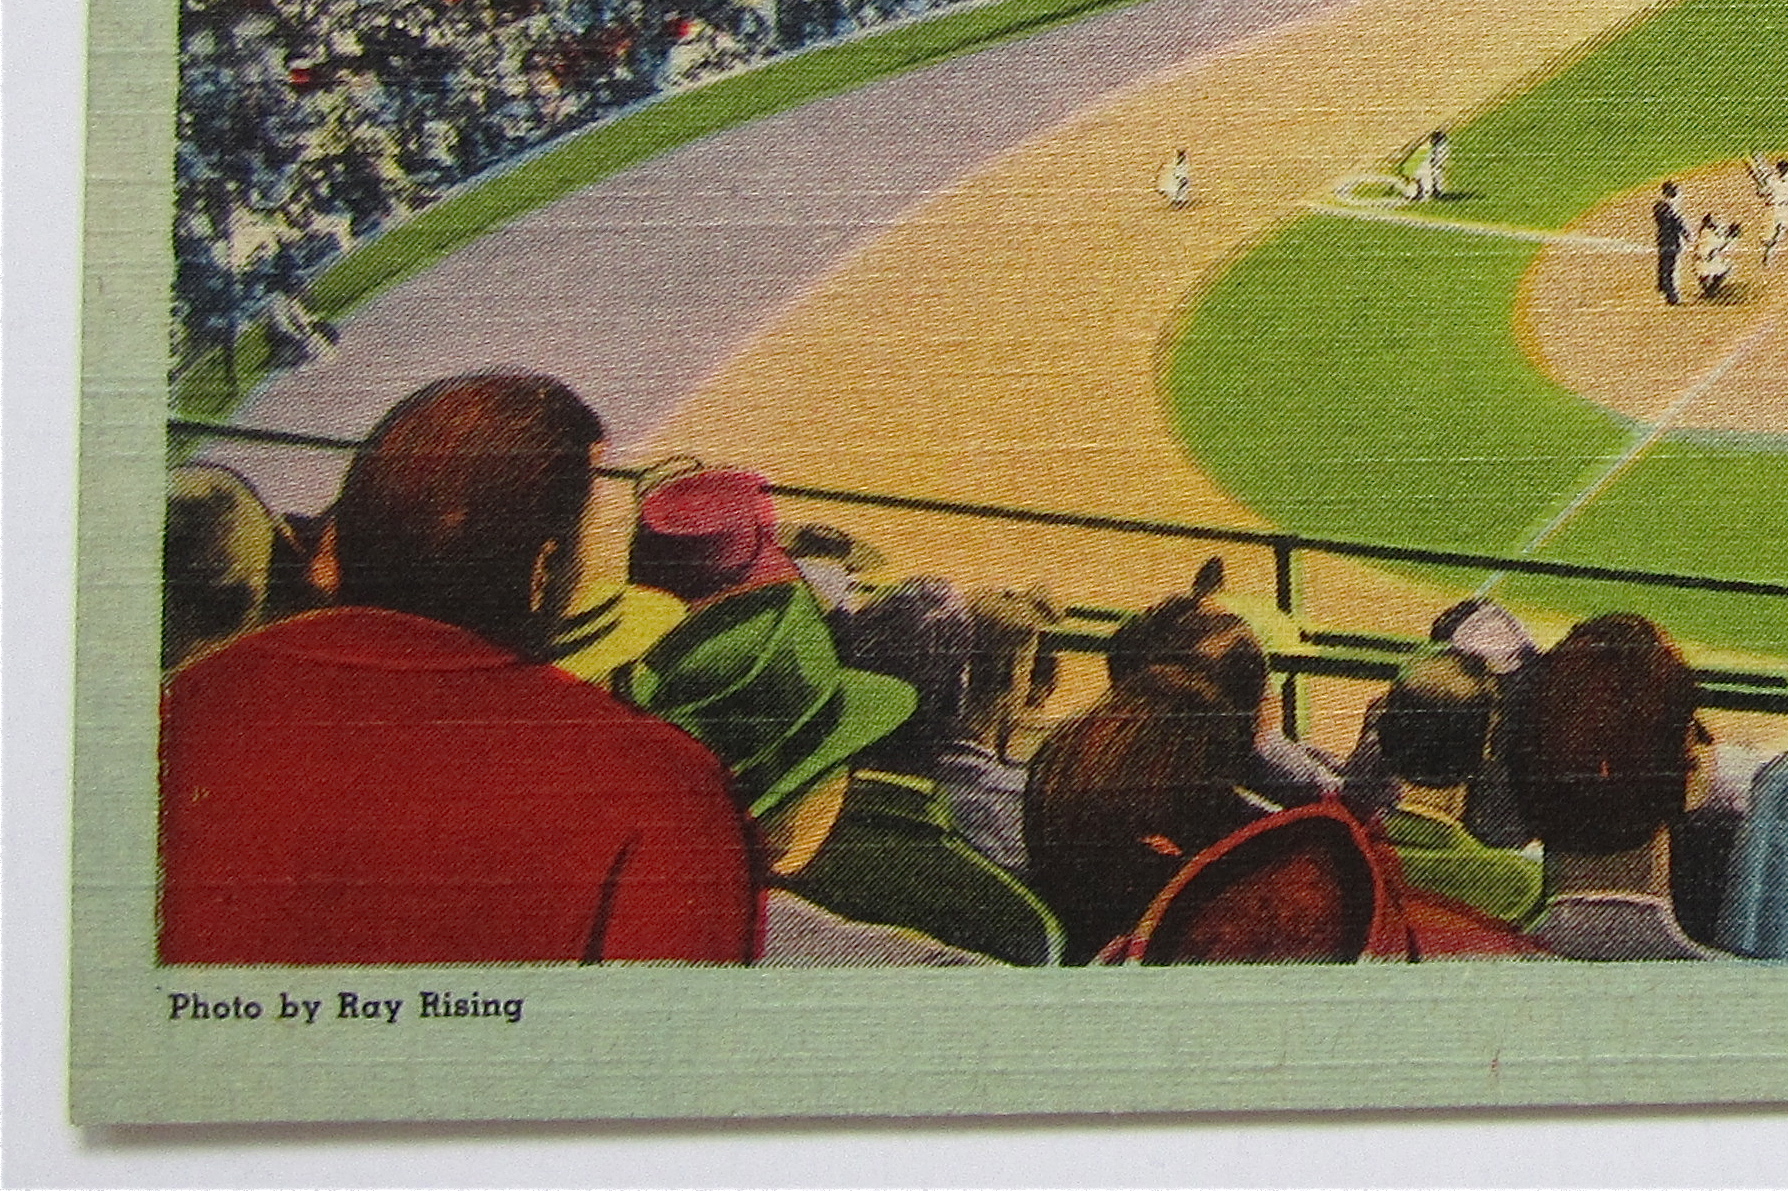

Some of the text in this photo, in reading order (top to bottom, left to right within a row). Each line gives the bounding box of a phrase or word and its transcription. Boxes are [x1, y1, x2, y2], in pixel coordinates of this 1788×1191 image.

[168, 990, 524, 1024] Photo by Ray Rising
